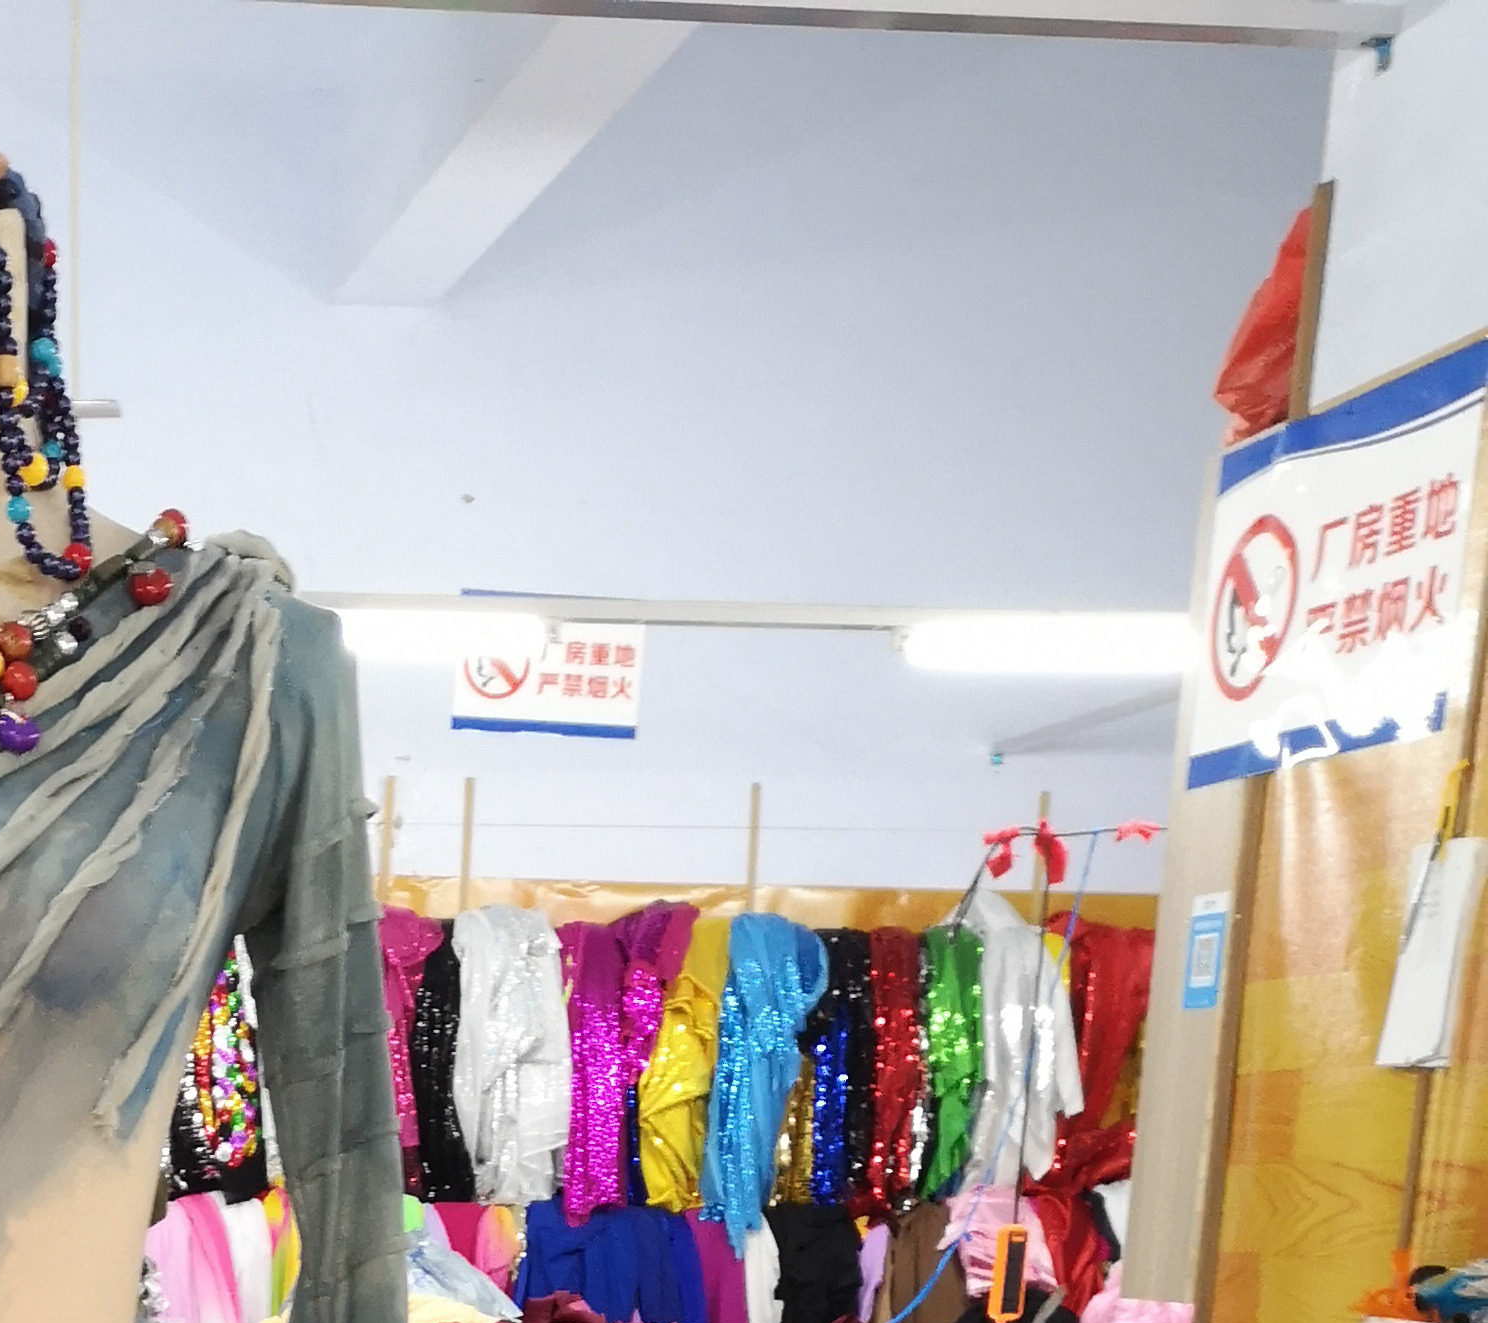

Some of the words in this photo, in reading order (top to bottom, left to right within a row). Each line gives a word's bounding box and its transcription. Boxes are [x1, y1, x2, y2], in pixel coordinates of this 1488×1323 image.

[1311, 472, 1461, 582] 厂房重地
[536, 672, 633, 700] 严禁烟火
